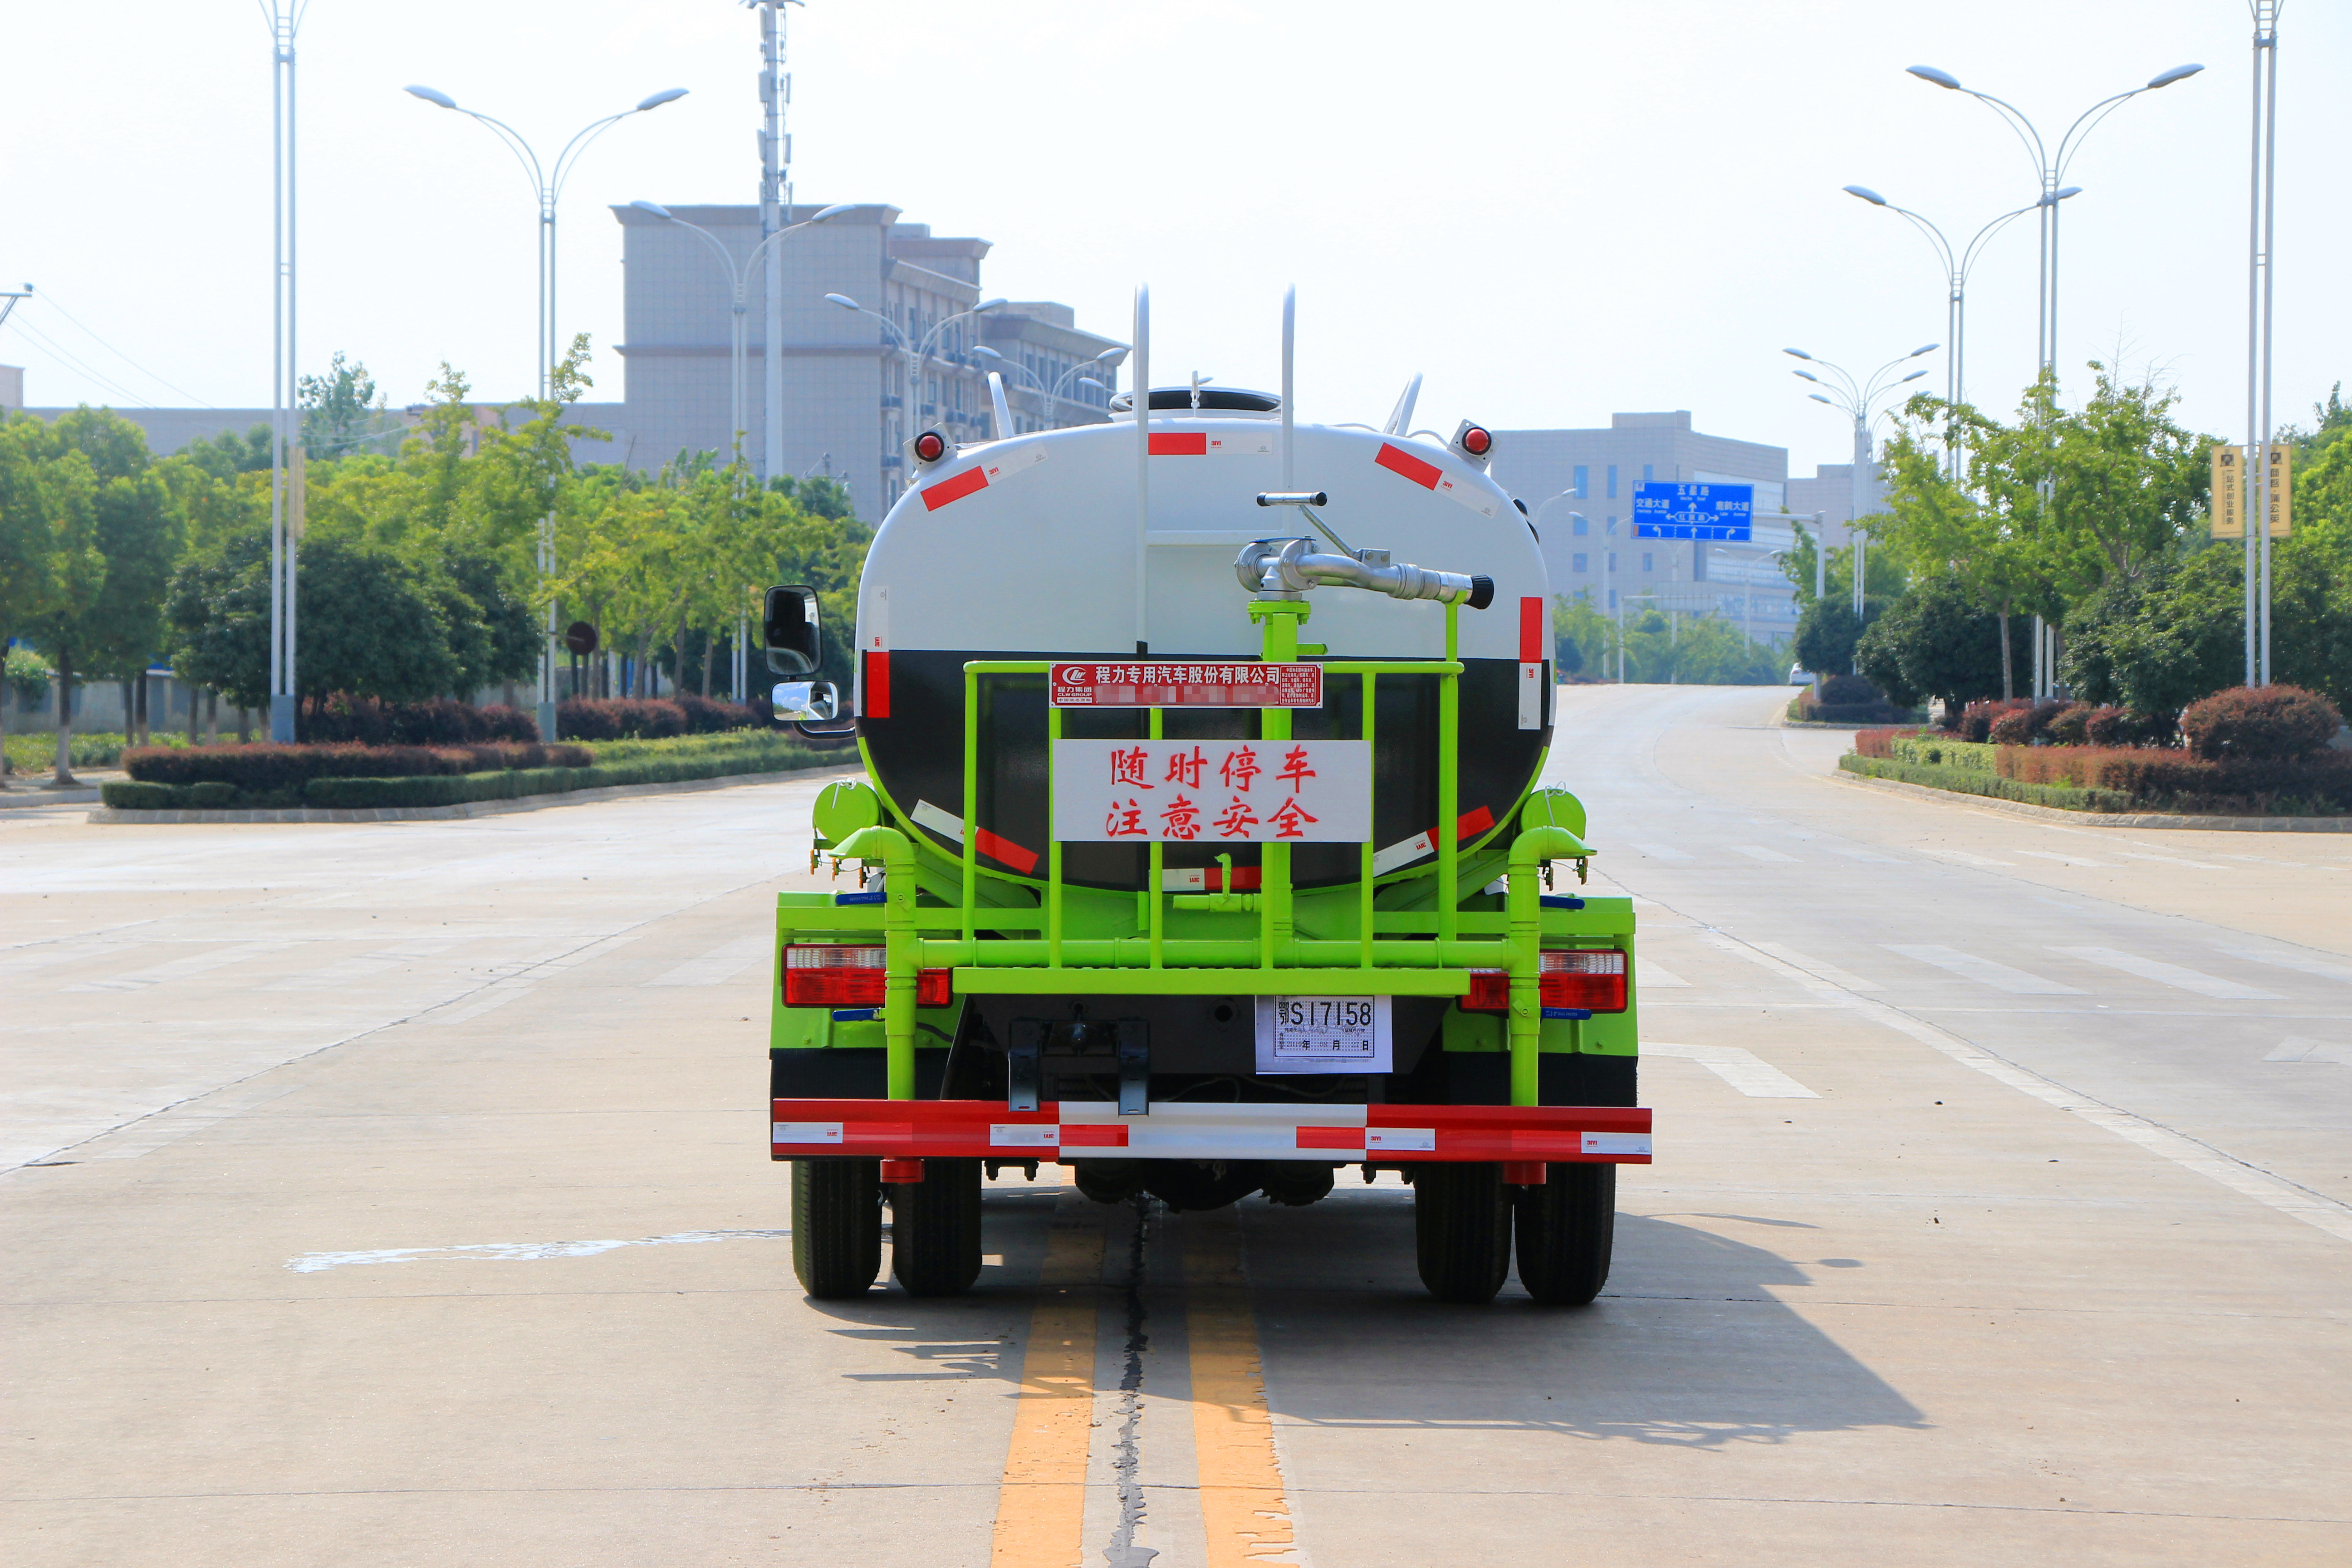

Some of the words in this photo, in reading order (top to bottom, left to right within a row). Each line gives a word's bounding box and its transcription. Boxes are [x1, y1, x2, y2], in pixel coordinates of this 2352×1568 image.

[1636, 498, 1670, 509] 交通大道
[2226, 469, 2234, 524] 一站式创业服务
[1095, 666, 1280, 685] 程力专用汽车股份有限公司
[1111, 745, 1316, 794] 随时停车
[1106, 794, 1319, 840] 注意安全
[1279, 1002, 1371, 1026] 鄂S17158
